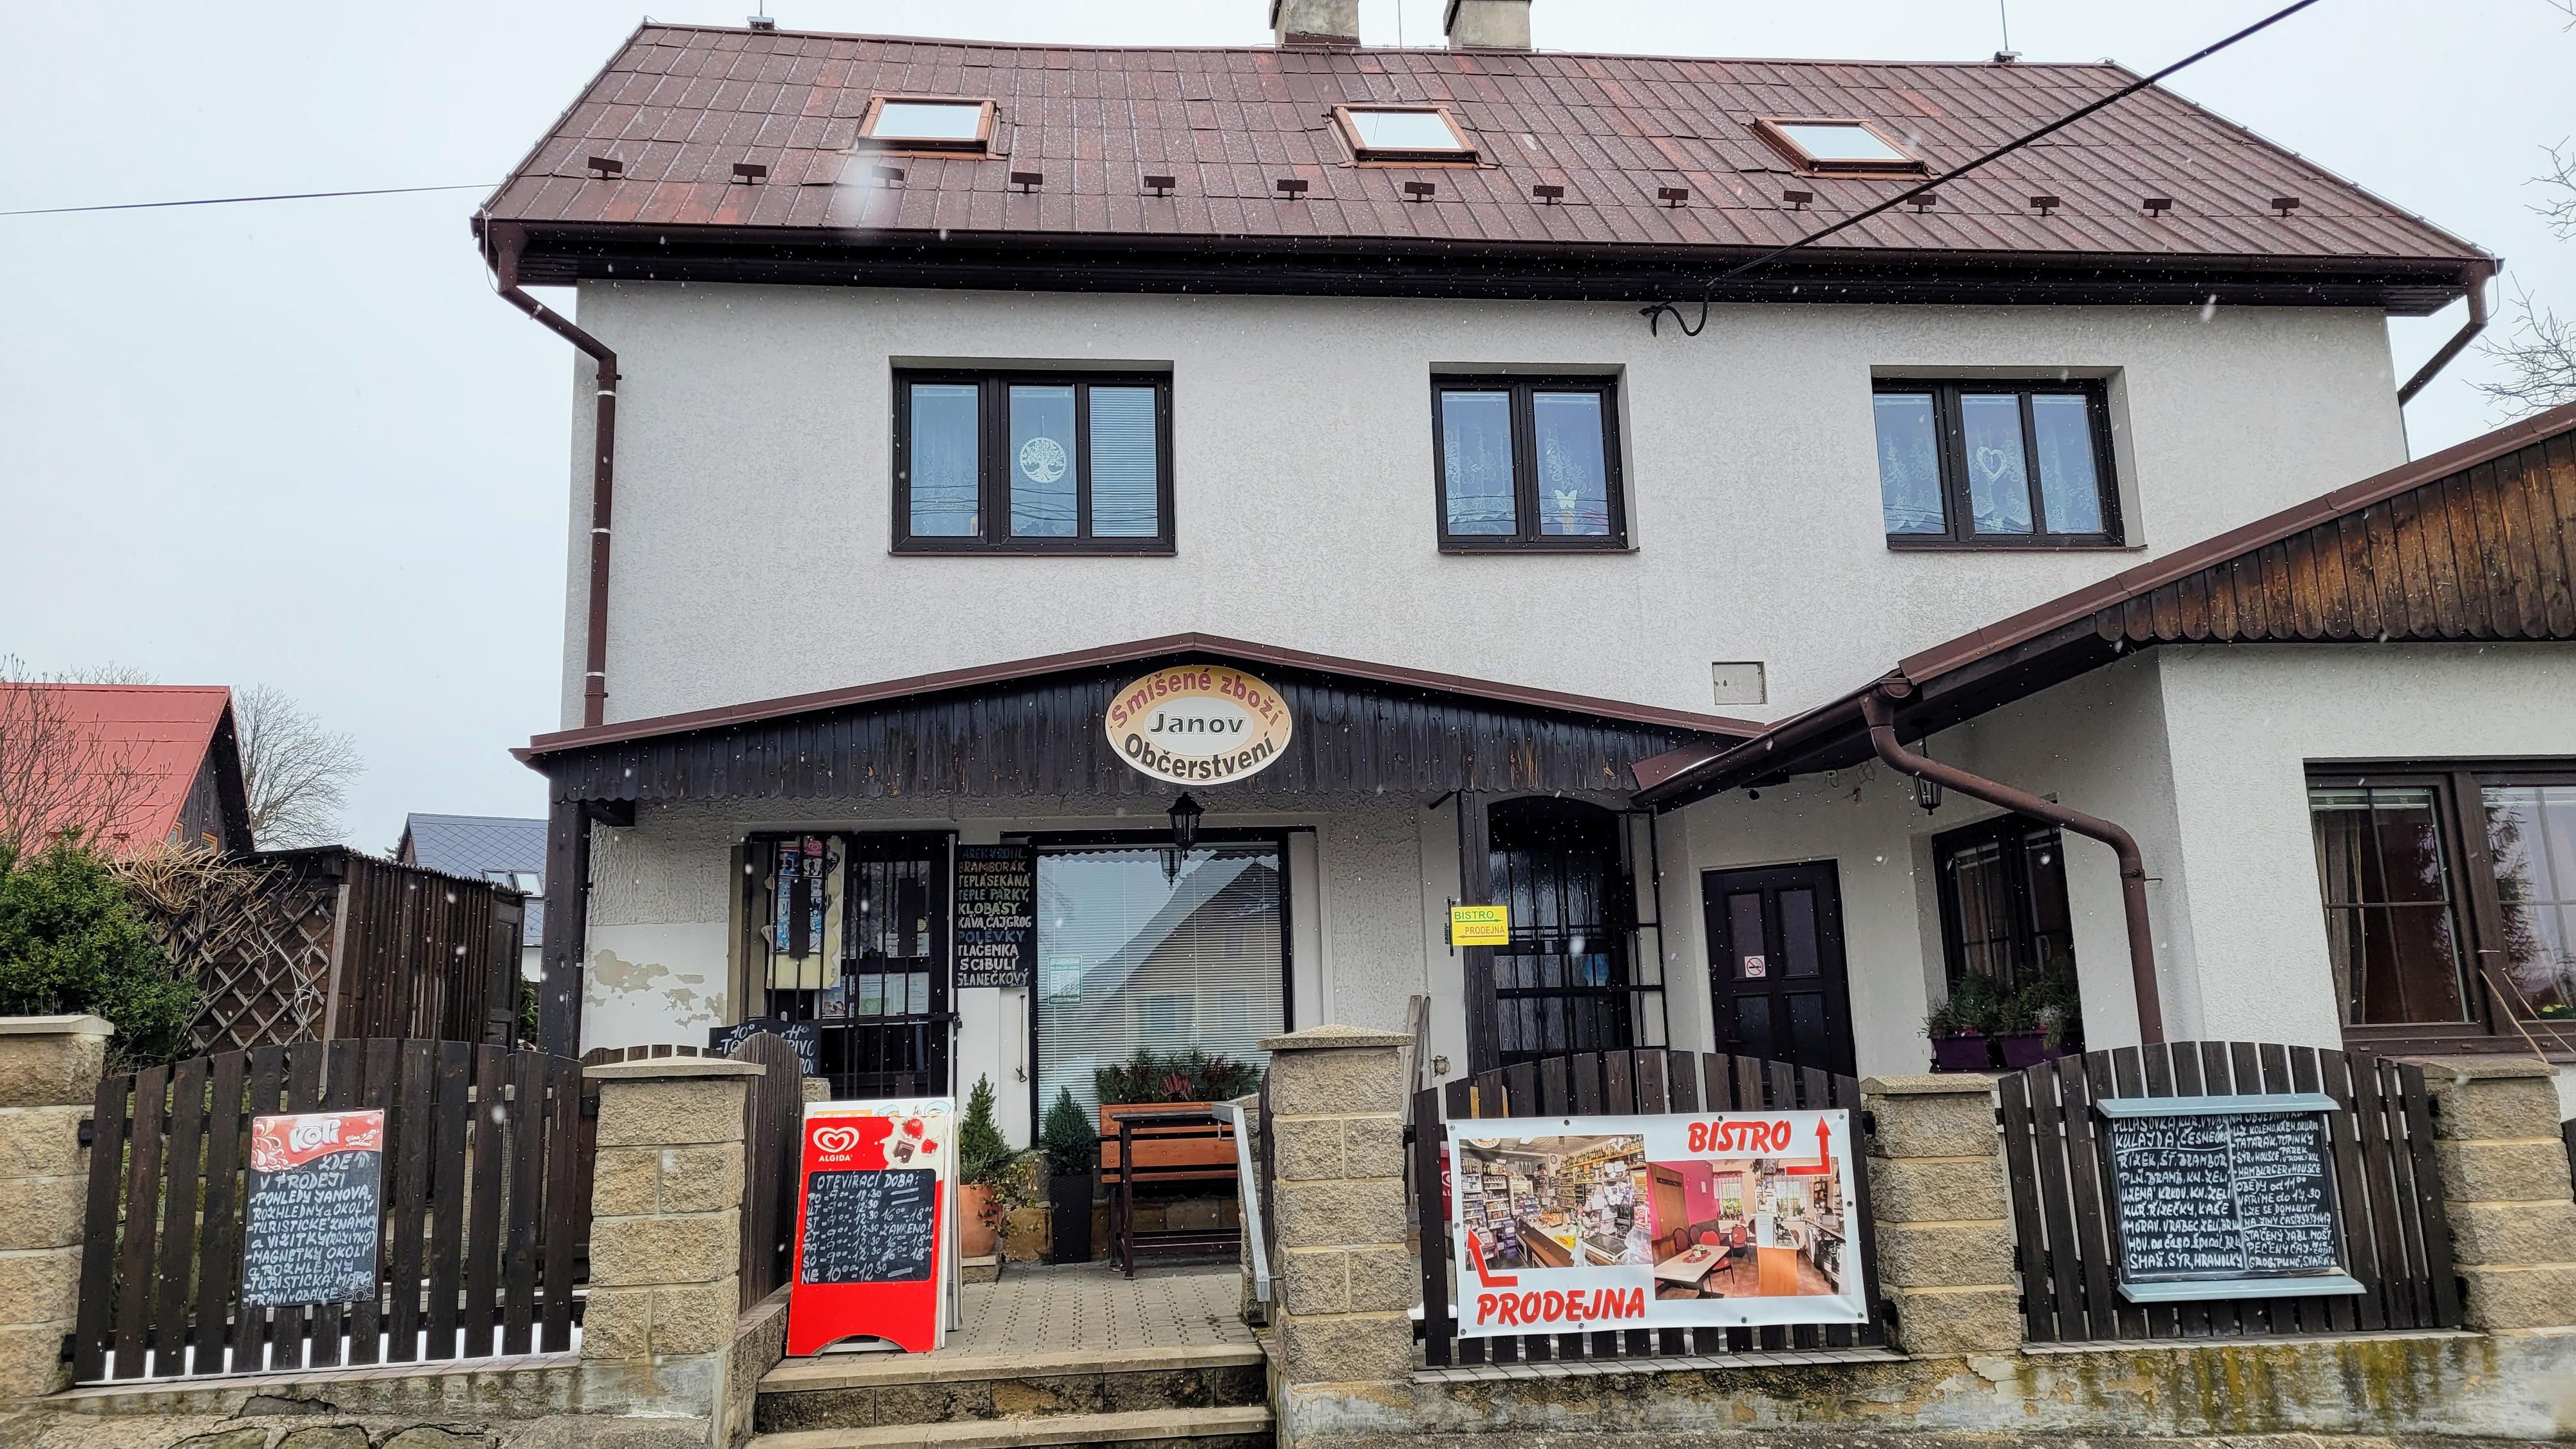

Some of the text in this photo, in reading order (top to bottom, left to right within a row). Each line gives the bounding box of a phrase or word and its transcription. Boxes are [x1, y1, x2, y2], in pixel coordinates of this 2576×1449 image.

[1112, 668, 1284, 728] Smíšené zboží
[1150, 710, 1247, 734] Janov
[1125, 731, 1274, 779] Občerstvení
[1006, 915, 1032, 928] GROG
[1454, 911, 1494, 920] BISTRO
[1464, 926, 1505, 934] PRODEJNA
[1687, 1120, 1792, 1154] BISTRO
[260, 1174, 270, 1190] V
[1475, 1287, 1646, 1328] PRODEJNA
